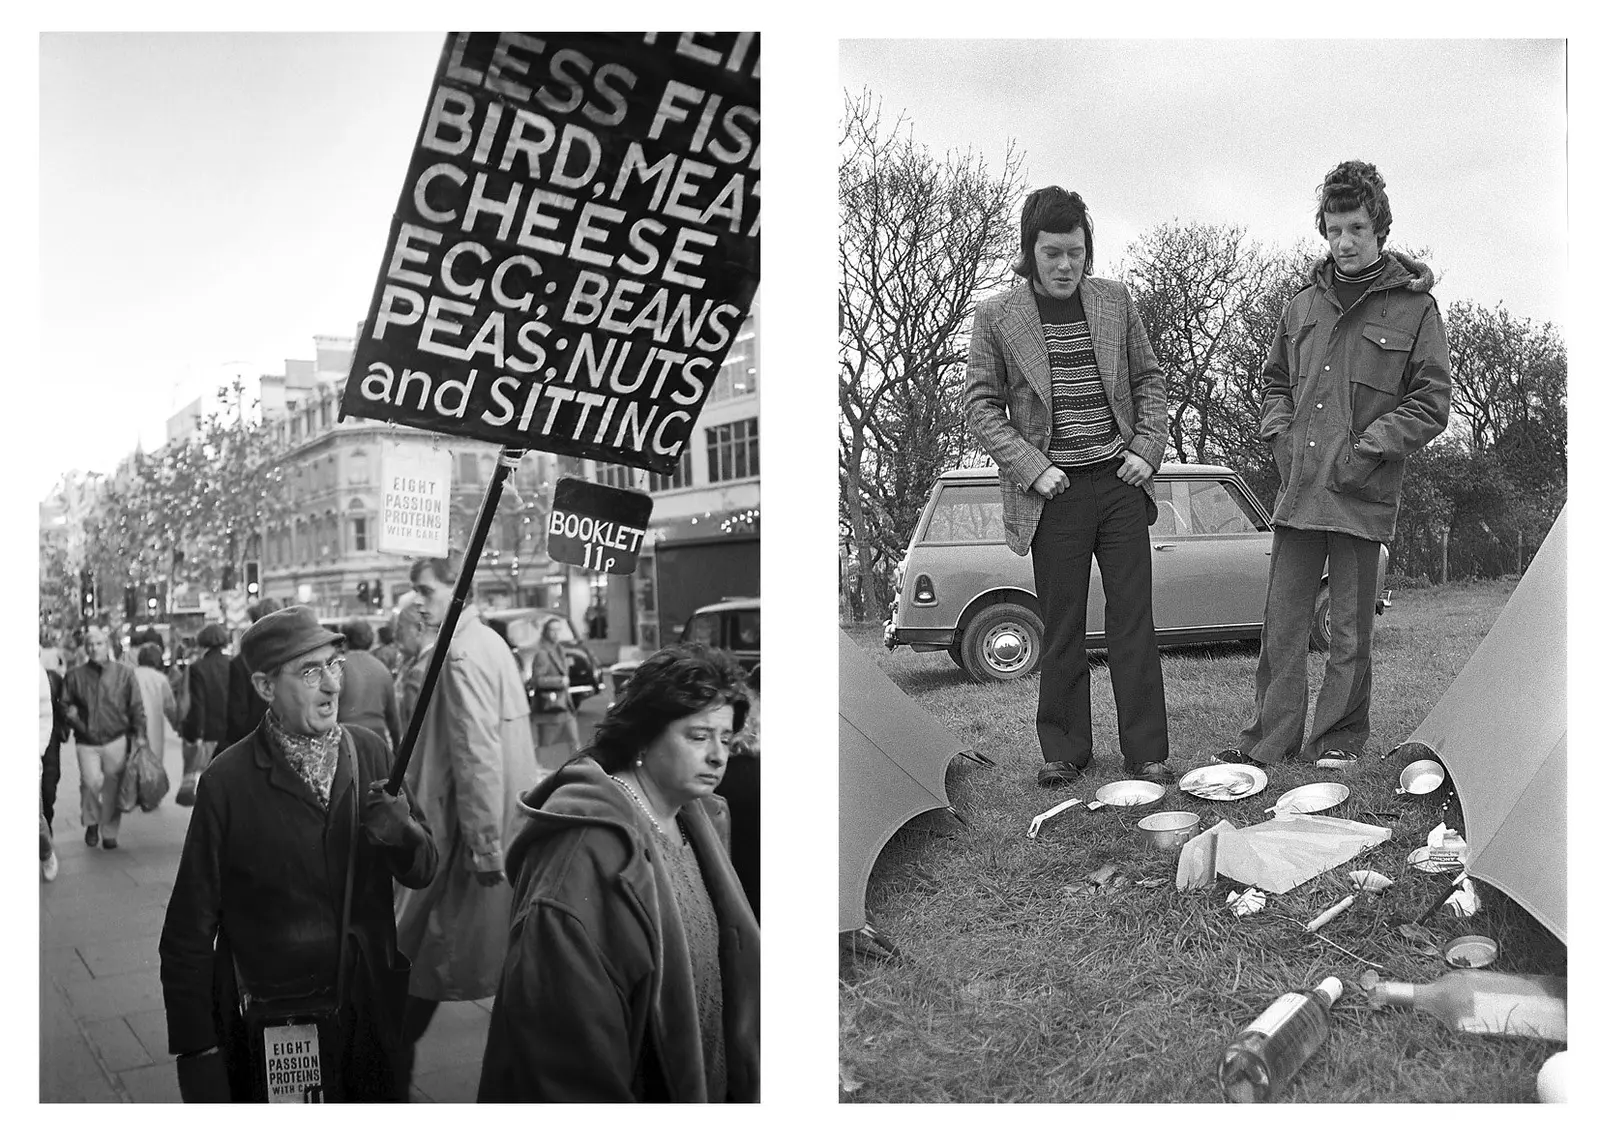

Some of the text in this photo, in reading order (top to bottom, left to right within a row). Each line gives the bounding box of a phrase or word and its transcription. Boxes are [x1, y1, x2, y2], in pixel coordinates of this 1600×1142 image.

[445, 32, 760, 171] LESS FIS
[421, 85, 605, 199] BIRD,
[413, 162, 718, 289] CHEESE
[387, 222, 740, 352] EGG; BEANS
[371, 284, 713, 406] PEAS; NUTS
[359, 359, 691, 457] and SITTING
[393, 476, 436, 495] EIGHT
[385, 493, 441, 513] PASSION
[384, 509, 442, 529] PROTEINS
[387, 525, 412, 537] WITH
[549, 510, 645, 552] BOOKLET
[583, 542, 615, 572] 11p
[273, 1040, 311, 1056] EIGHT
[268, 1055, 319, 1072] PASSION
[269, 1068, 320, 1085] PROTEINS
[272, 1085, 295, 1095] WITH
